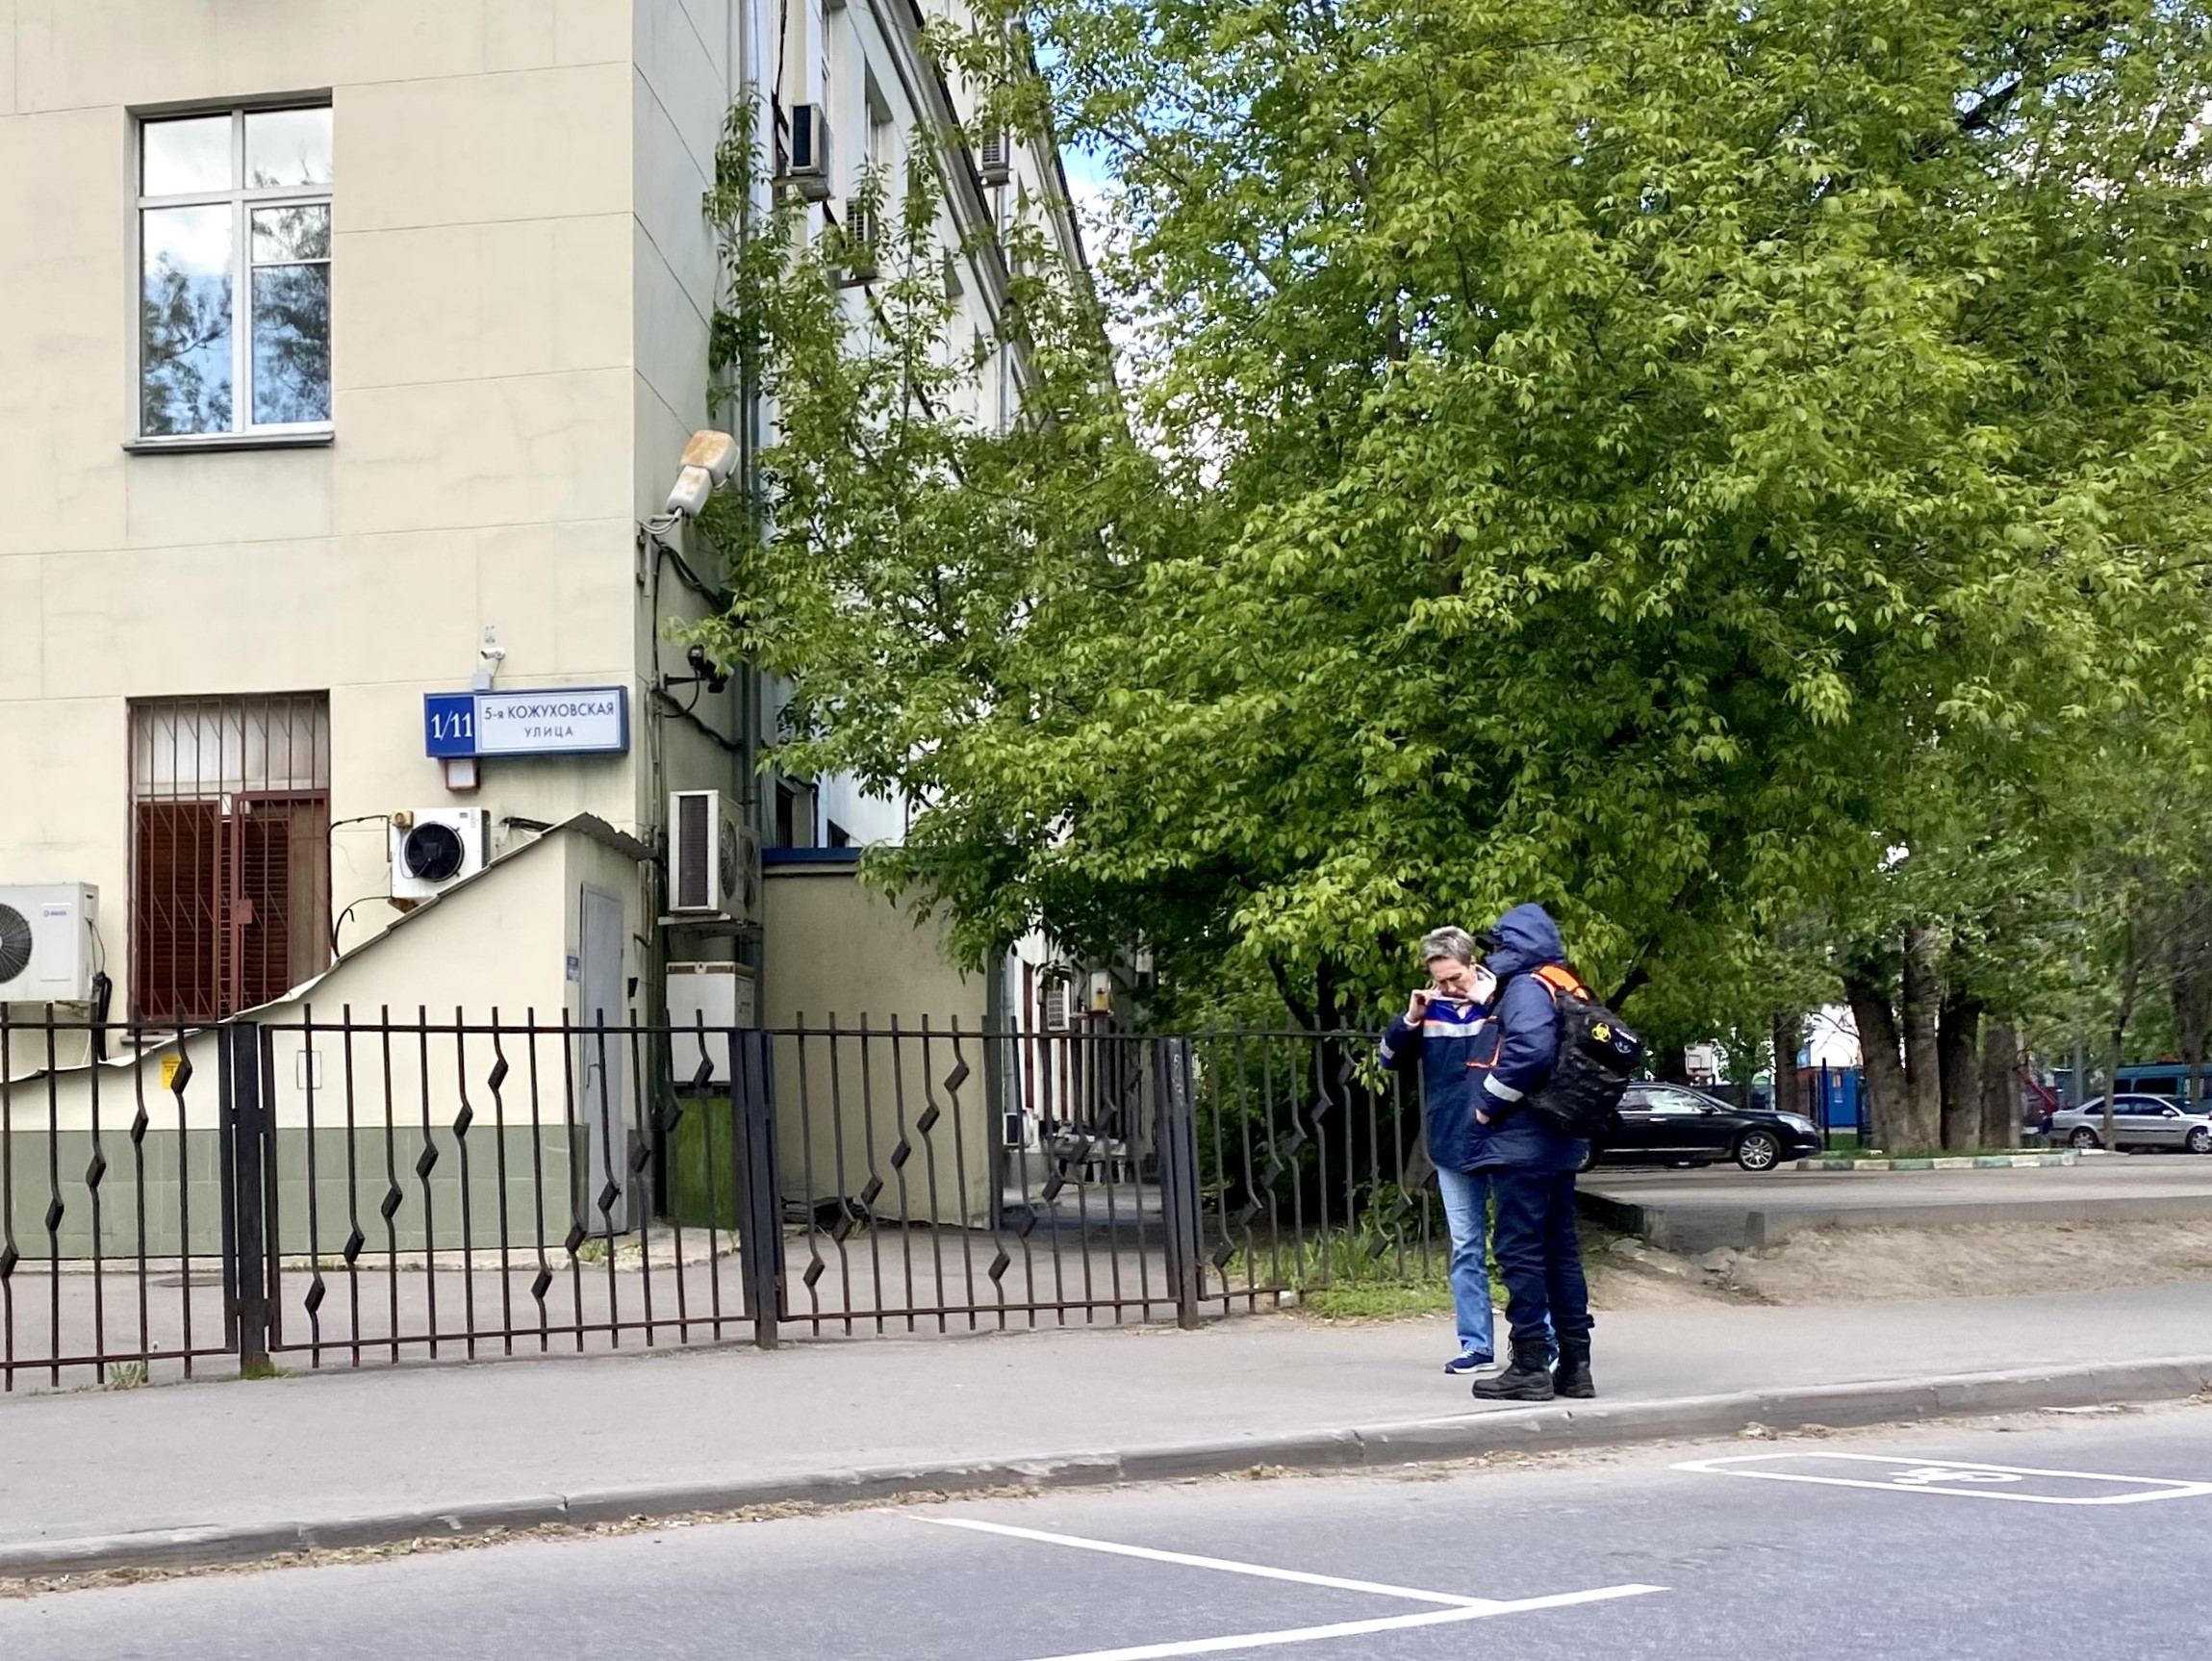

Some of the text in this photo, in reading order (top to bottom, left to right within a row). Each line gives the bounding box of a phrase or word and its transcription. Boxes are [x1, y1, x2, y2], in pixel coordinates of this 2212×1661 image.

[484, 702, 614, 720] 5-я КОЖУХОВСКАЯ
[431, 710, 472, 740] 1/11
[524, 725, 573, 738] УЛИЦА
